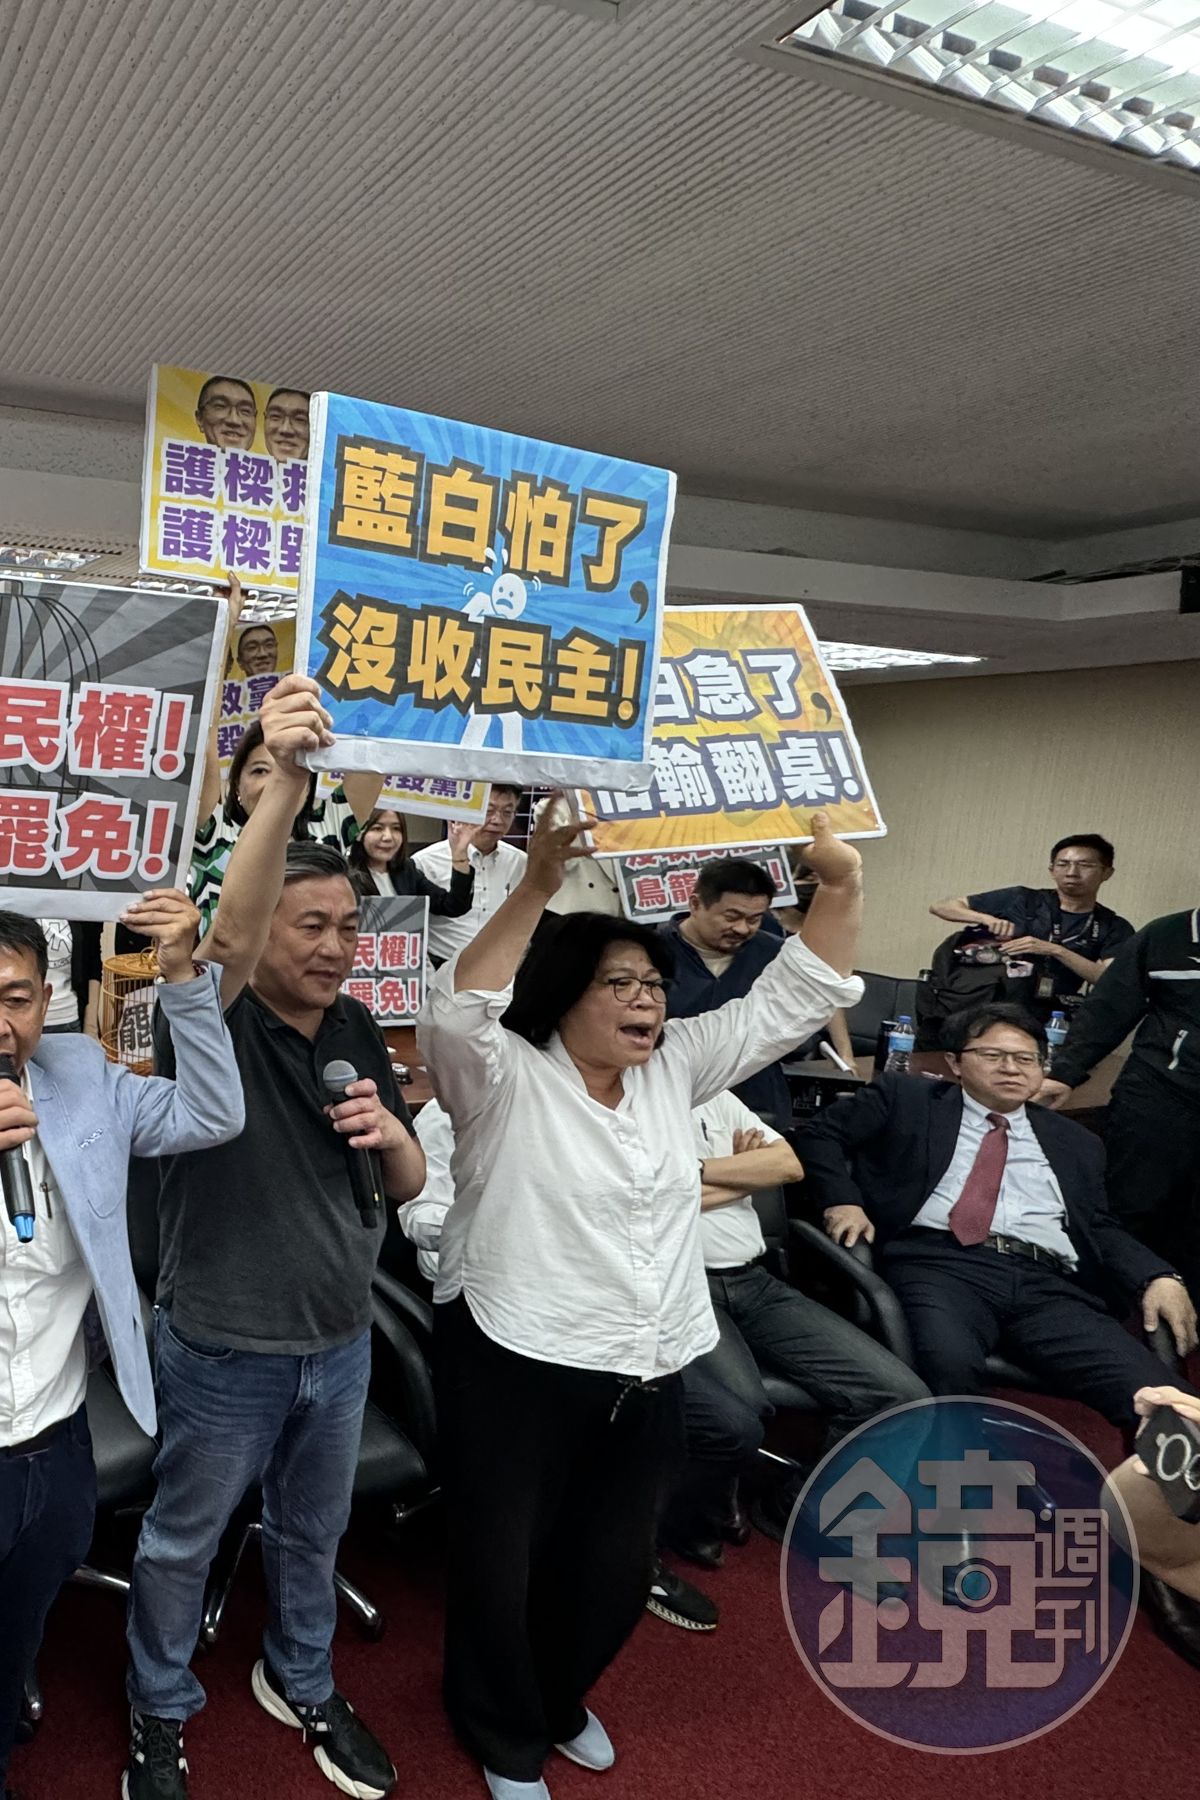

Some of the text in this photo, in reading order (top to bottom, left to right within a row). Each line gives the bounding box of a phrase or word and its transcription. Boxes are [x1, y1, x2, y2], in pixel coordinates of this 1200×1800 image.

[335, 445, 648, 624] 藍白怕了,
[326, 602, 641, 722] 沒收民主!
